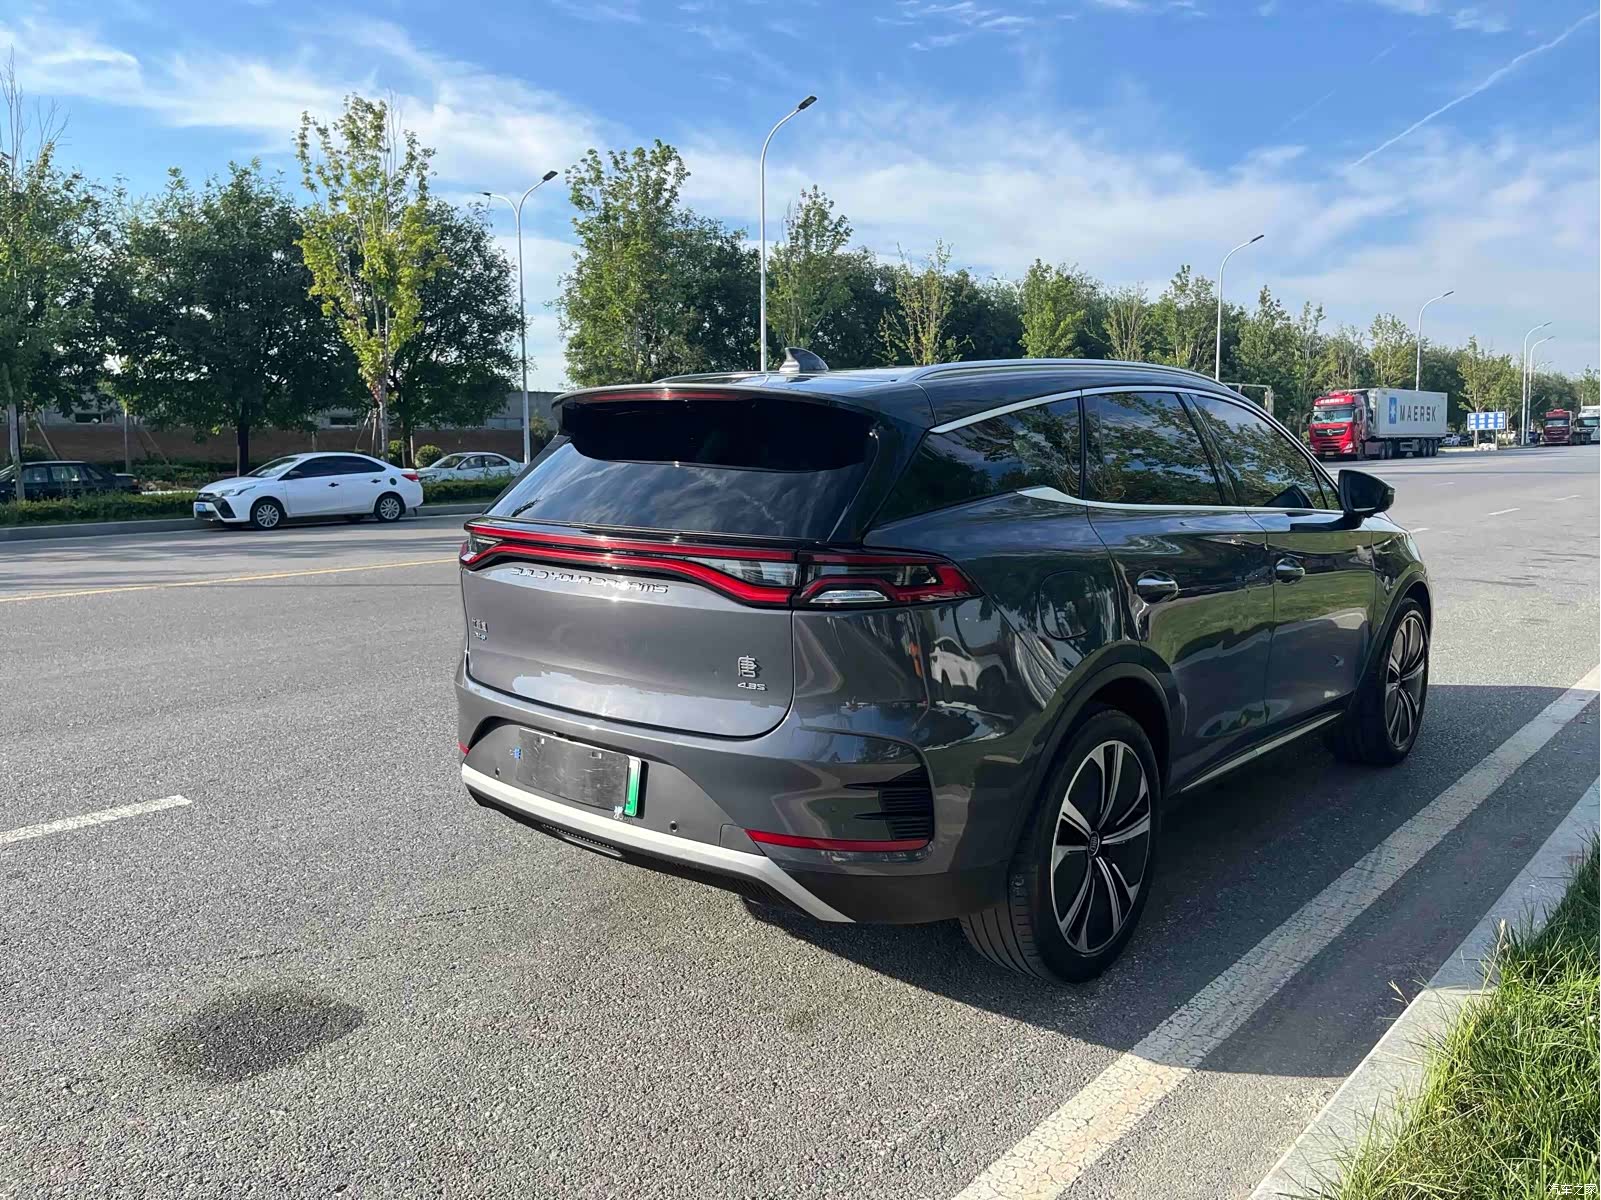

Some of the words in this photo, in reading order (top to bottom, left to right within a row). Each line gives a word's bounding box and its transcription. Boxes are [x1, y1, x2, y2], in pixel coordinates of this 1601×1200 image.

[1400, 404, 1436, 422] MAERSK
[511, 567, 549, 580] BUILD
[551, 571, 592, 584] YOUR
[592, 576, 669, 594] DRAMS
